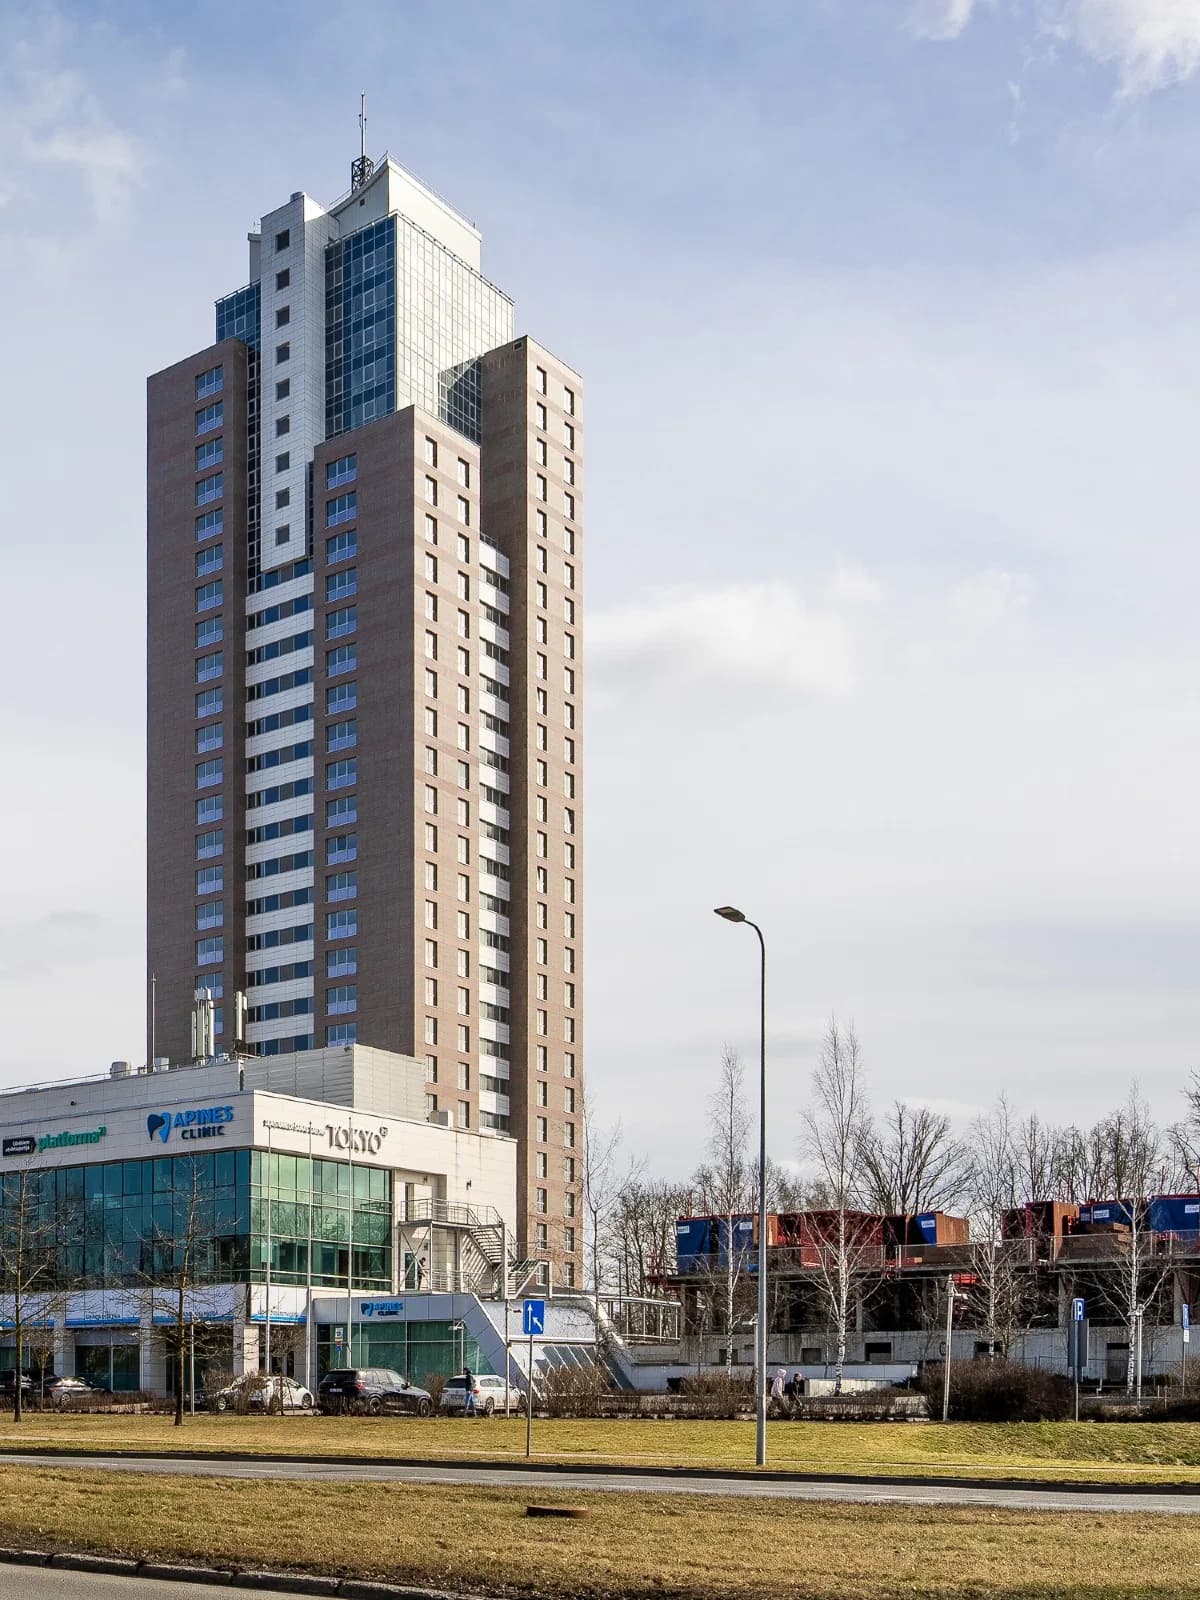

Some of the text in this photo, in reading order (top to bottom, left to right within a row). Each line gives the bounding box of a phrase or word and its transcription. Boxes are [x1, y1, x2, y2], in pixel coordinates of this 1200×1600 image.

[173, 1105, 235, 1128] APINES
[181, 1125, 225, 1140] CLINIC
[326, 1124, 382, 1155] TOKYO
